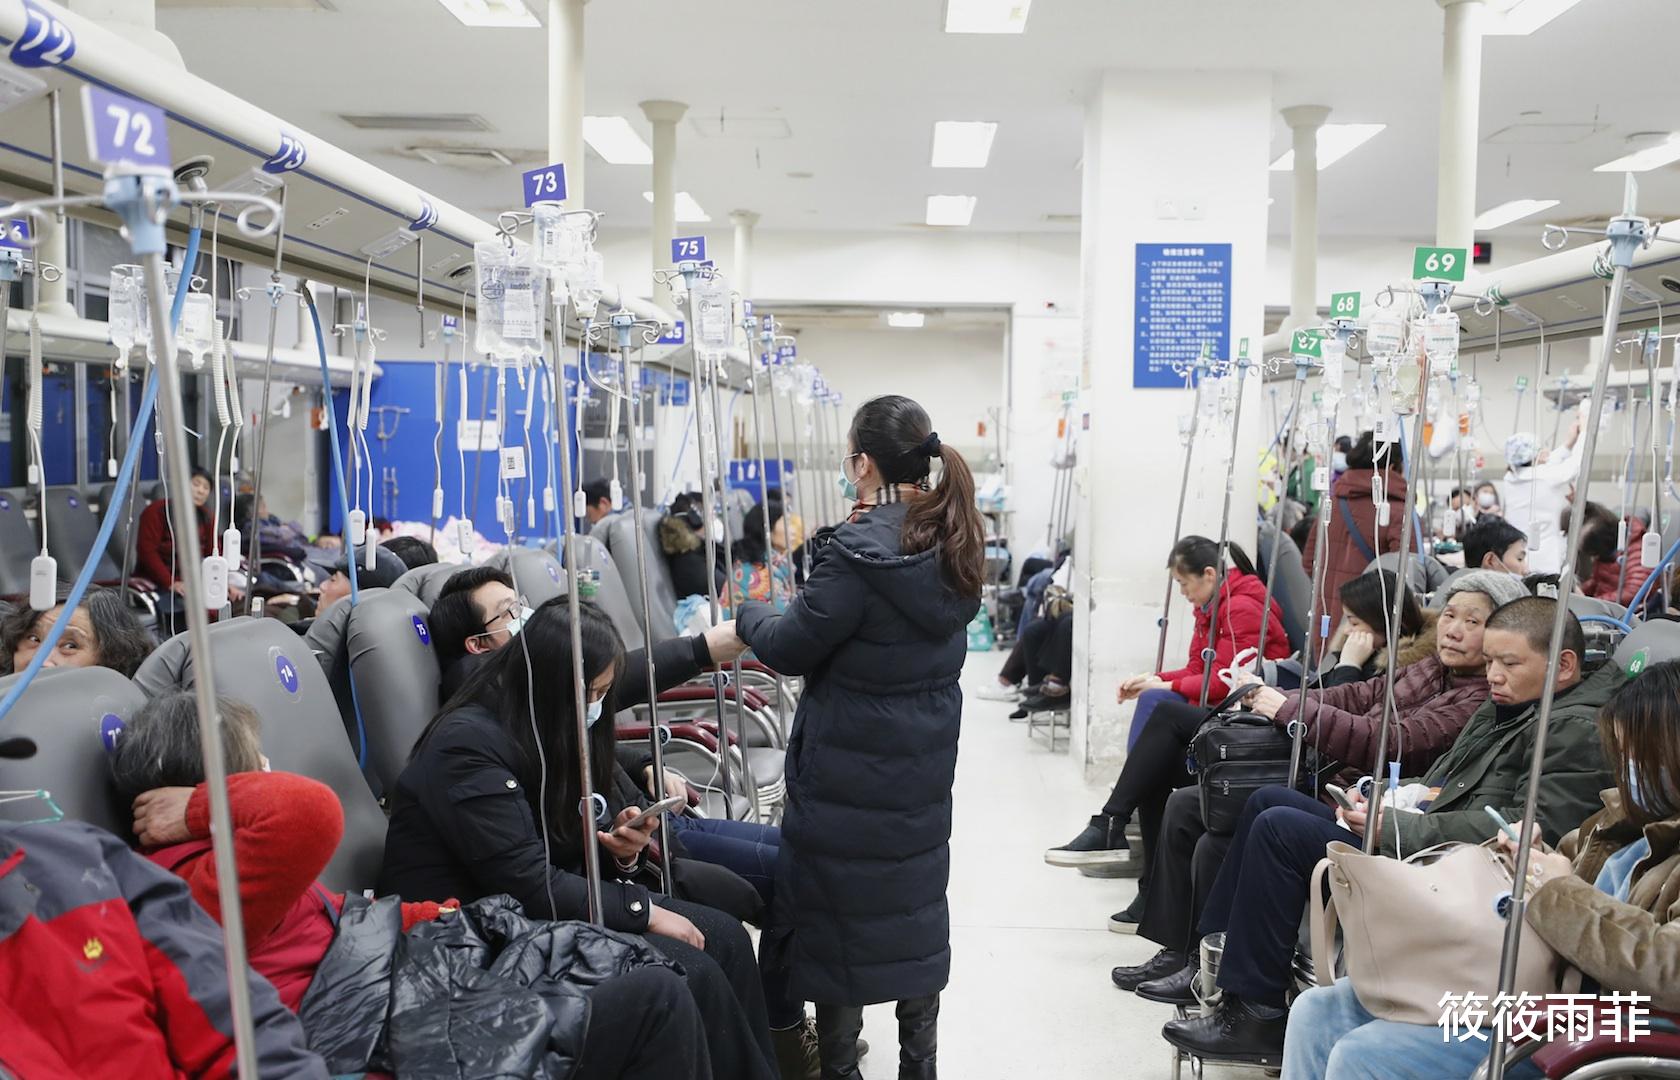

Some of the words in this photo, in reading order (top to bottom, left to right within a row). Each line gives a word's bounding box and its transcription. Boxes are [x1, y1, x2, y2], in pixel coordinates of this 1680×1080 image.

[21, 7, 73, 64] 72
[107, 105, 155, 156] 72
[273, 136, 304, 168] 73
[532, 171, 557, 197] 73
[679, 241, 699, 256] 75
[1425, 253, 1456, 272] 69
[1336, 296, 1353, 311] 68
[416, 624, 426, 635] 75
[281, 665, 293, 683] 74
[1630, 659, 1642, 672] 68
